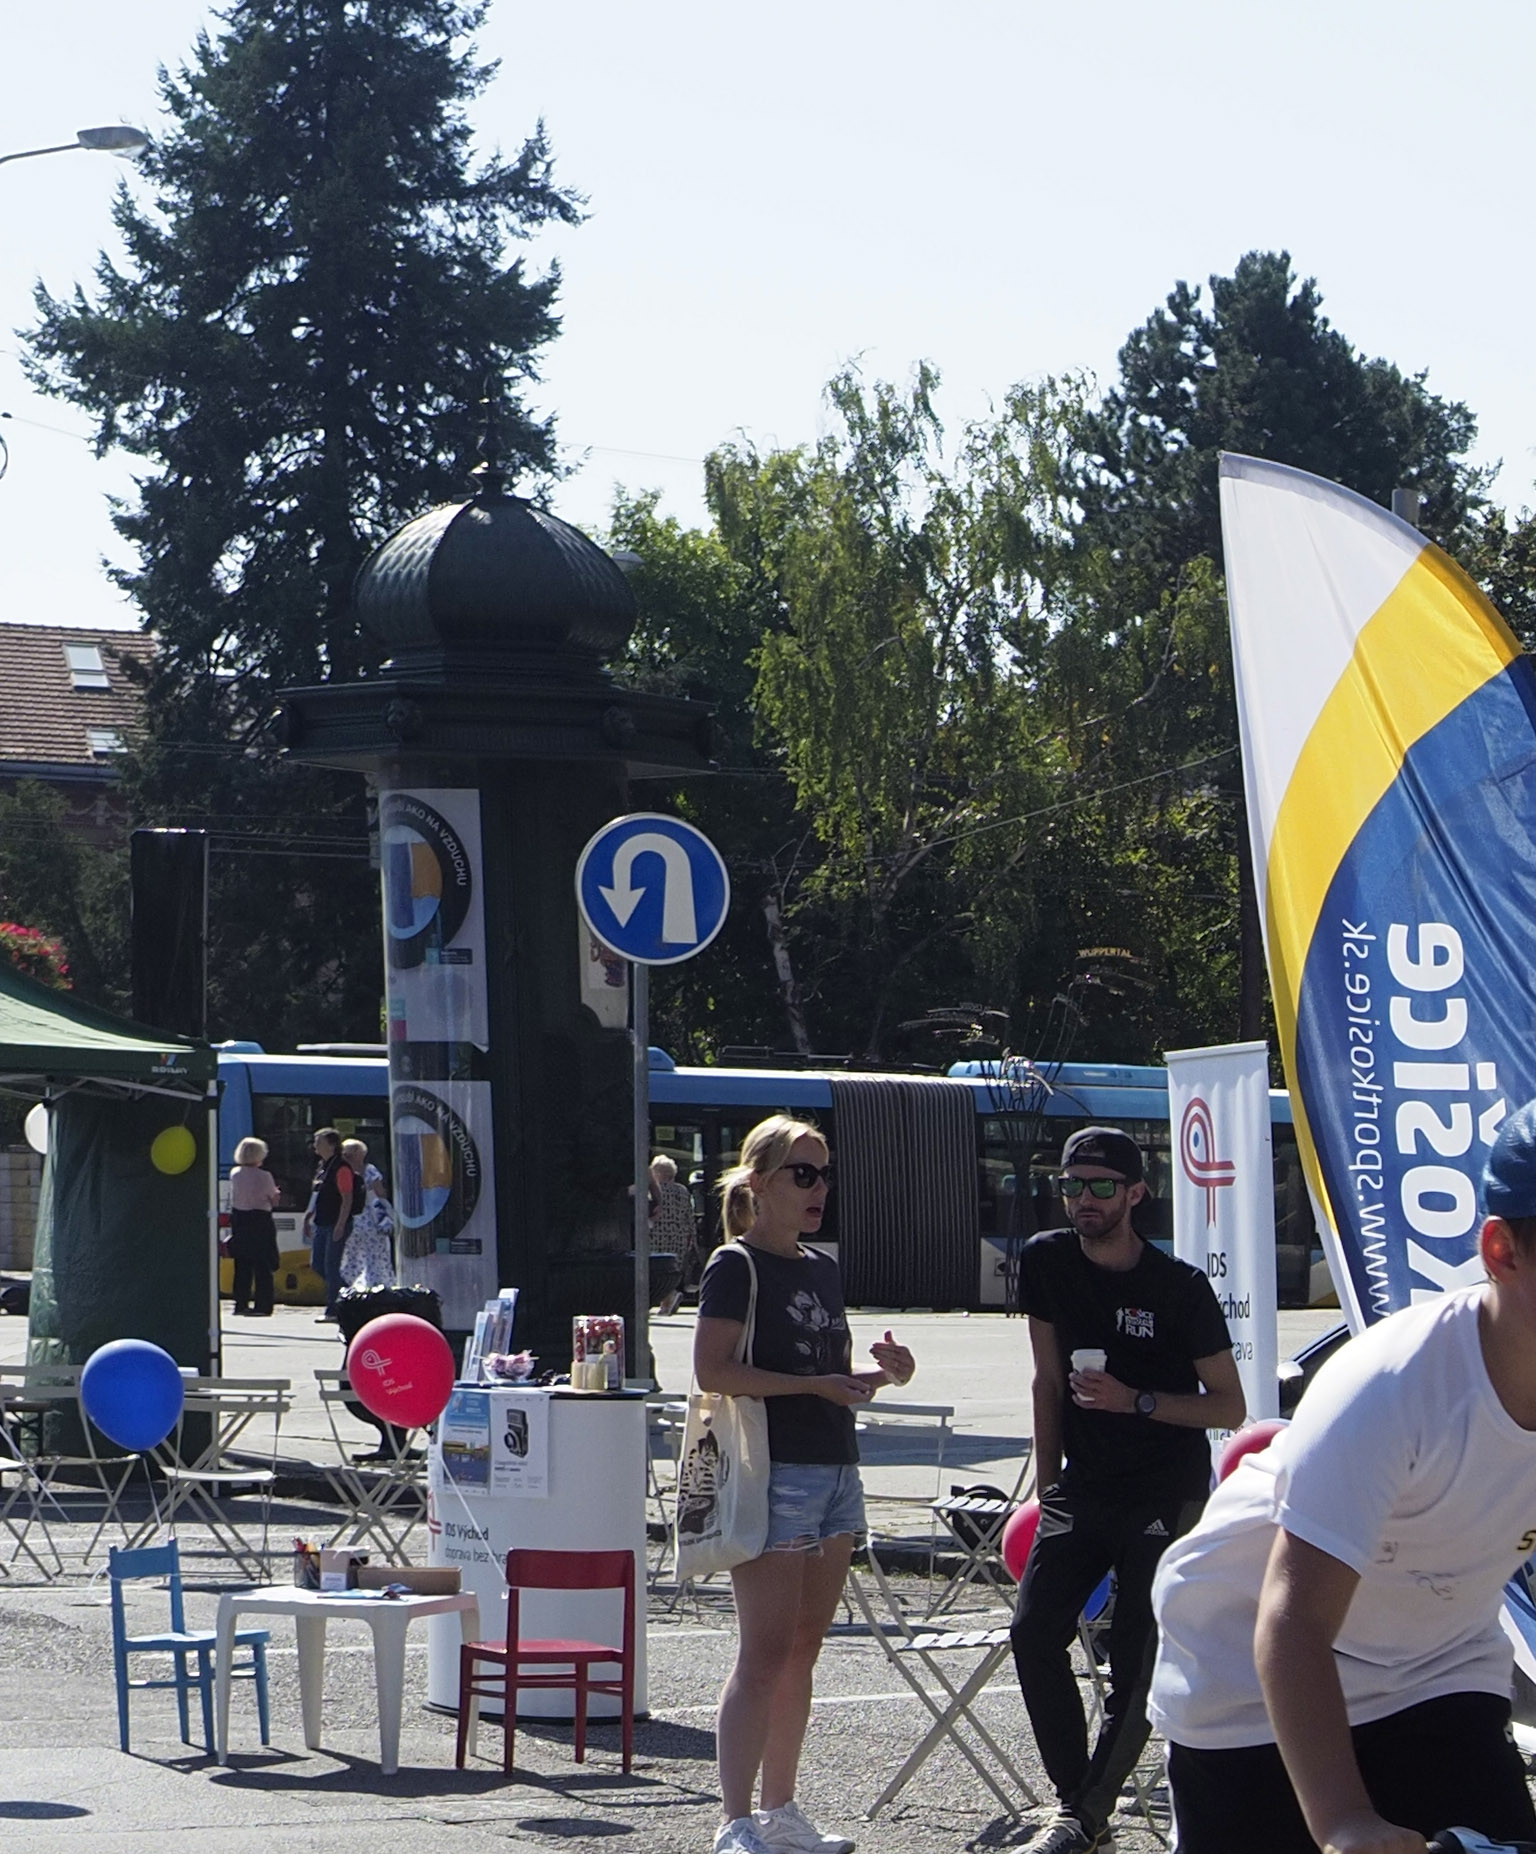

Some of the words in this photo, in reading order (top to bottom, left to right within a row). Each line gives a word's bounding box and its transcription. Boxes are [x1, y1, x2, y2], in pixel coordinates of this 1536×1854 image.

[439, 828, 468, 887] VZDUCHU
[450, 1120, 478, 1178] VZDUCHU
[1206, 1251, 1228, 1279] IDS
[1125, 1325, 1155, 1339] RUN
[444, 1522, 457, 1538] IDS
[457, 1524, 489, 1542] Východ
[473, 1547, 489, 1563] bez
